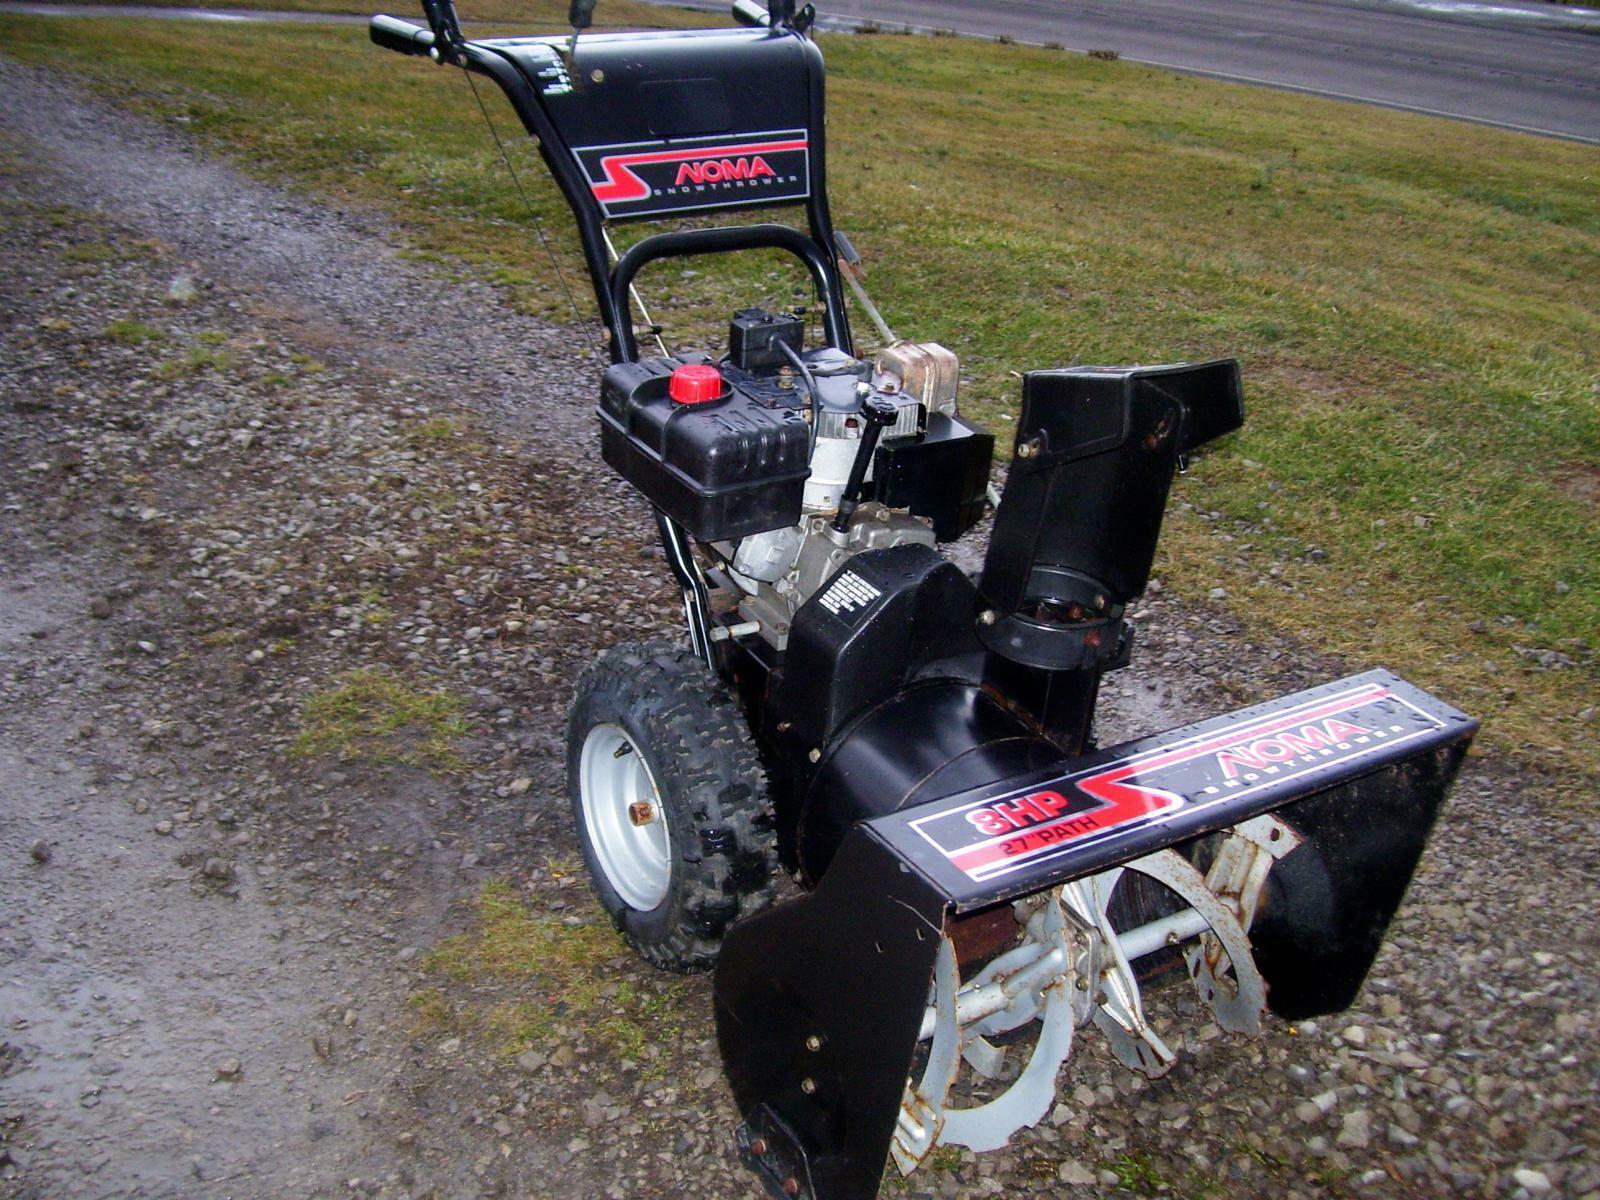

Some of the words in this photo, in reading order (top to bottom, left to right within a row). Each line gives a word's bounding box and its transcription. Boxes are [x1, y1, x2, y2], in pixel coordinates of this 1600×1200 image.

[654, 175, 797, 196] SNOWTHROWER
[675, 156, 775, 185] NOMA
[1202, 726, 1404, 795] SNOWTHROWER
[1215, 719, 1371, 780] NOMA
[966, 790, 1069, 835] 8HP
